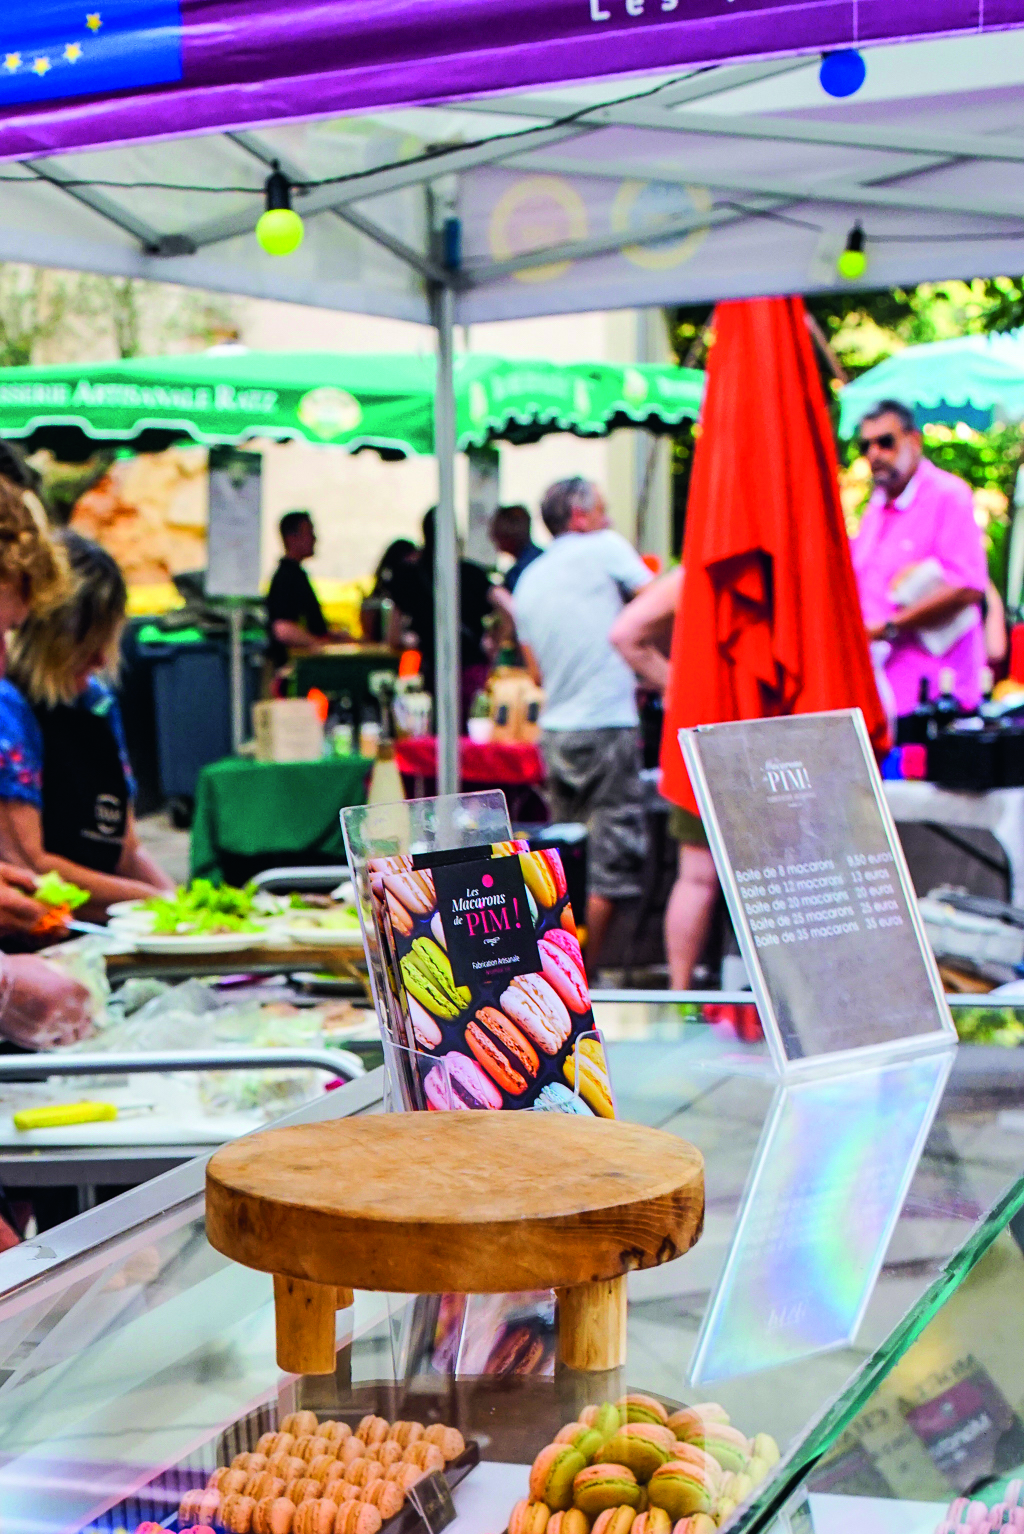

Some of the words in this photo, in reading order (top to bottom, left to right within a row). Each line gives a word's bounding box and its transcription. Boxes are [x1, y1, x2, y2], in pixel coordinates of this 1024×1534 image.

[786, 859, 835, 875] macarons
[782, 880, 796, 893] 12
[796, 875, 844, 891] macarons
[864, 868, 890, 882] euros
[452, 893, 506, 912] Macarons
[466, 888, 479, 898] Les
[787, 896, 800, 909] 20
[801, 890, 850, 906] macarons
[855, 886, 868, 899] 20
[868, 884, 895, 897] euros
[453, 916, 463, 926] de
[805, 906, 855, 923] macarons
[873, 899, 899, 912] euros
[810, 921, 860, 938] macarons
[878, 915, 903, 928] euros
